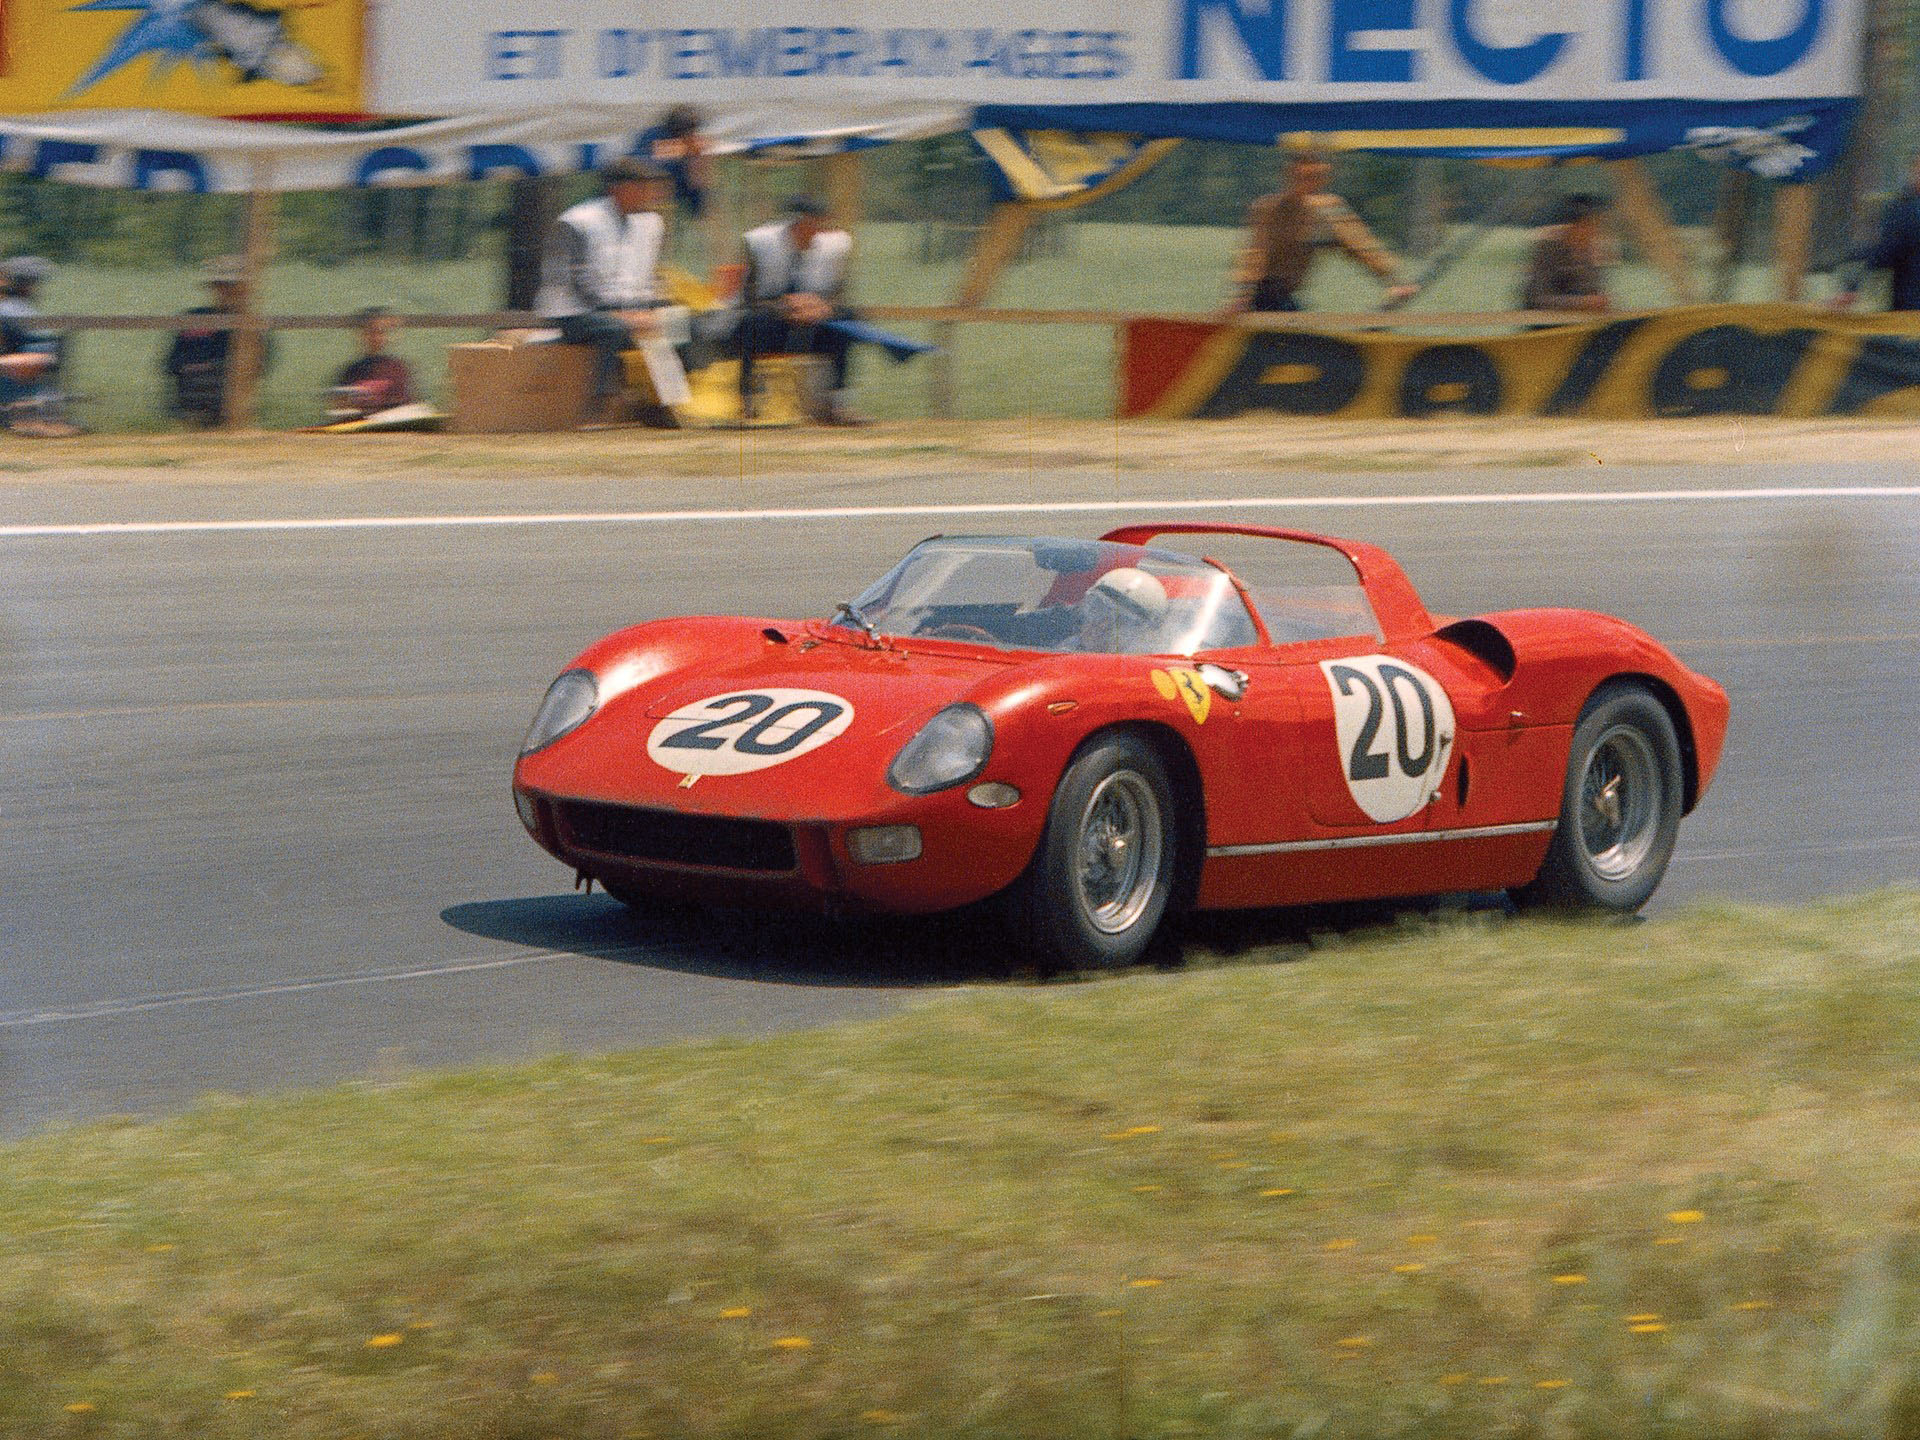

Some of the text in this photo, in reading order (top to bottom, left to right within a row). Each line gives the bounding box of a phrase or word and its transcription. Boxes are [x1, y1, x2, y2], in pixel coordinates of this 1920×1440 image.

[486, 29, 573, 80] ET
[658, 694, 844, 755] 20
[1331, 664, 1435, 781] 20
